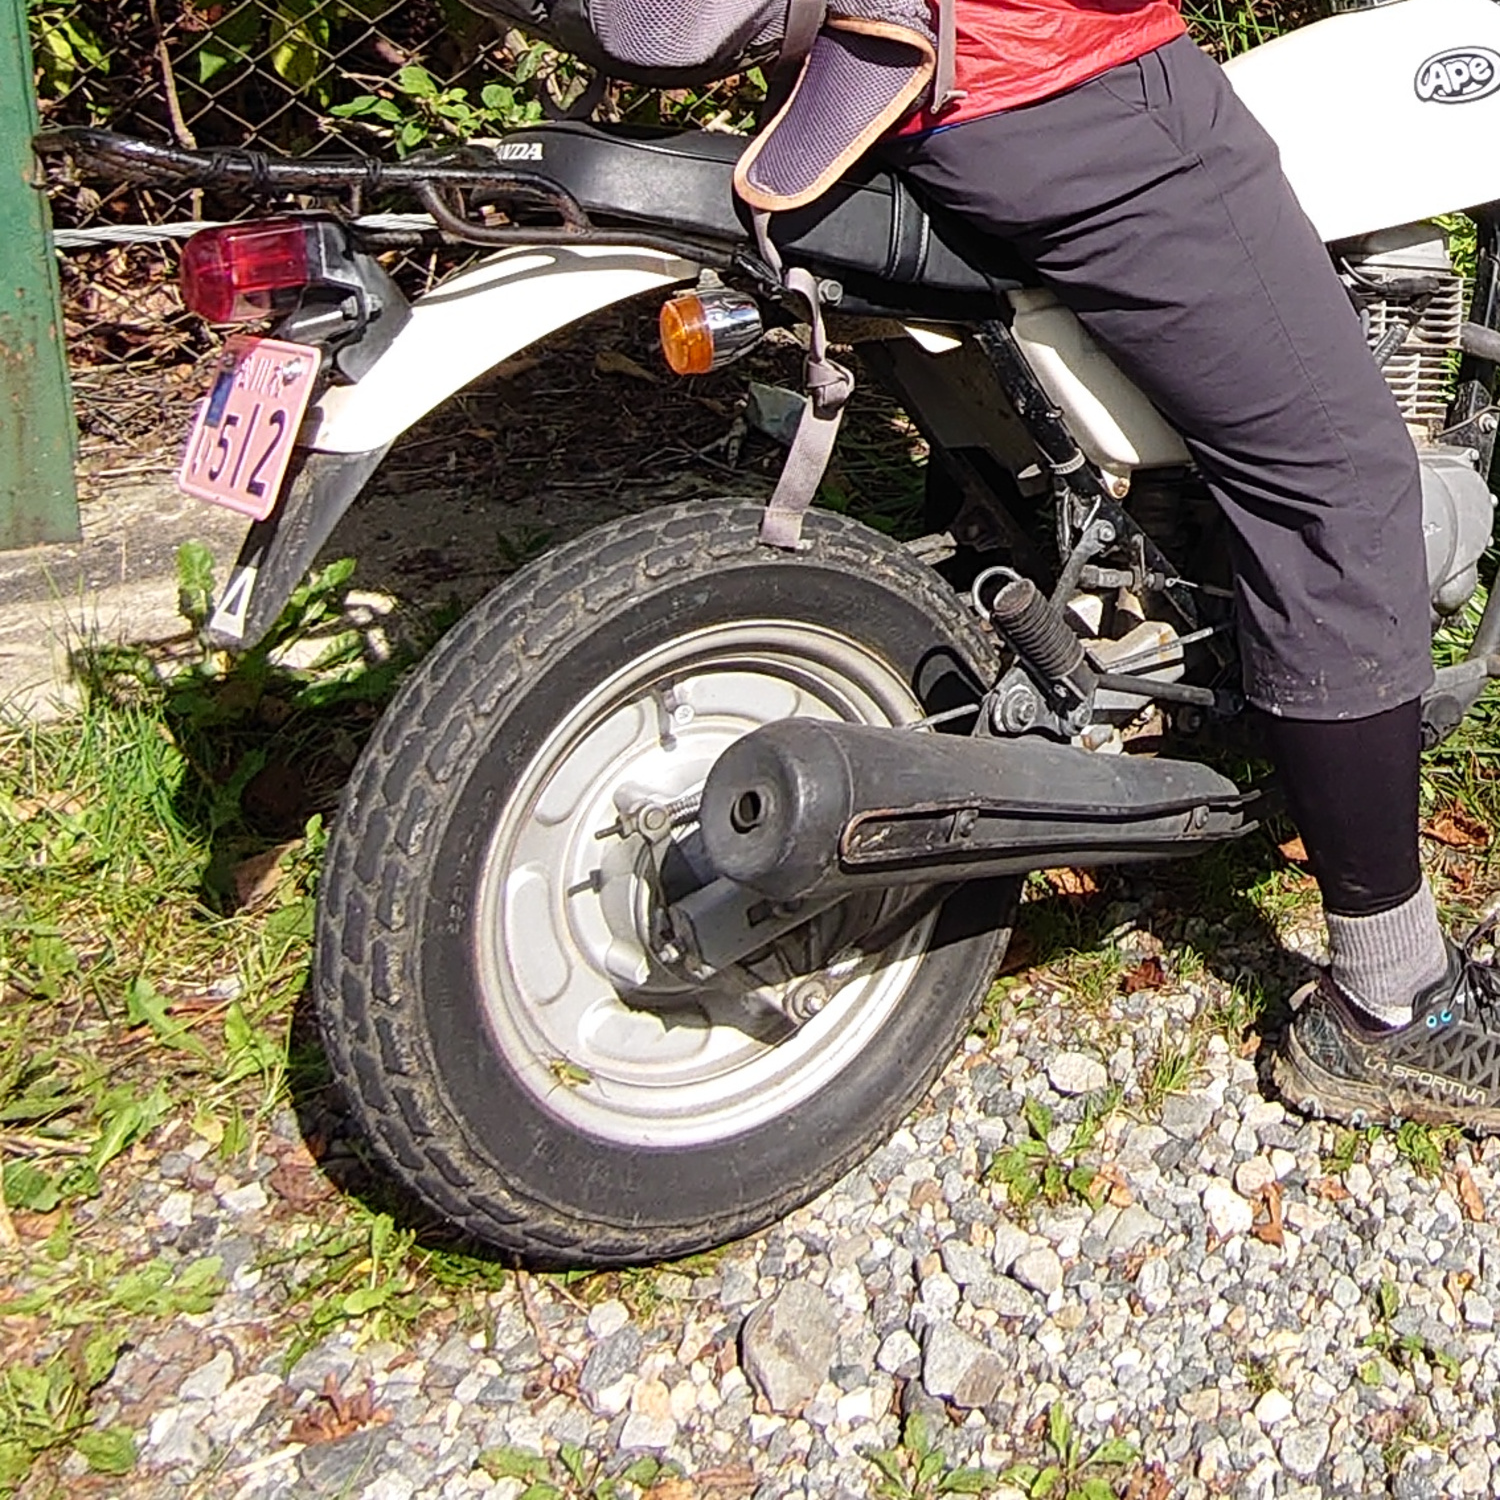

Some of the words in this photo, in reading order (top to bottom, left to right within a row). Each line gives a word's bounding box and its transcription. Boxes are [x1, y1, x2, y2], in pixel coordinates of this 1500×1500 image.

[495, 142, 543, 161] NDA
[208, 402, 287, 498] 512
[1363, 1056, 1388, 1074] LA
[1391, 1063, 1487, 1106] SPORTIVA
